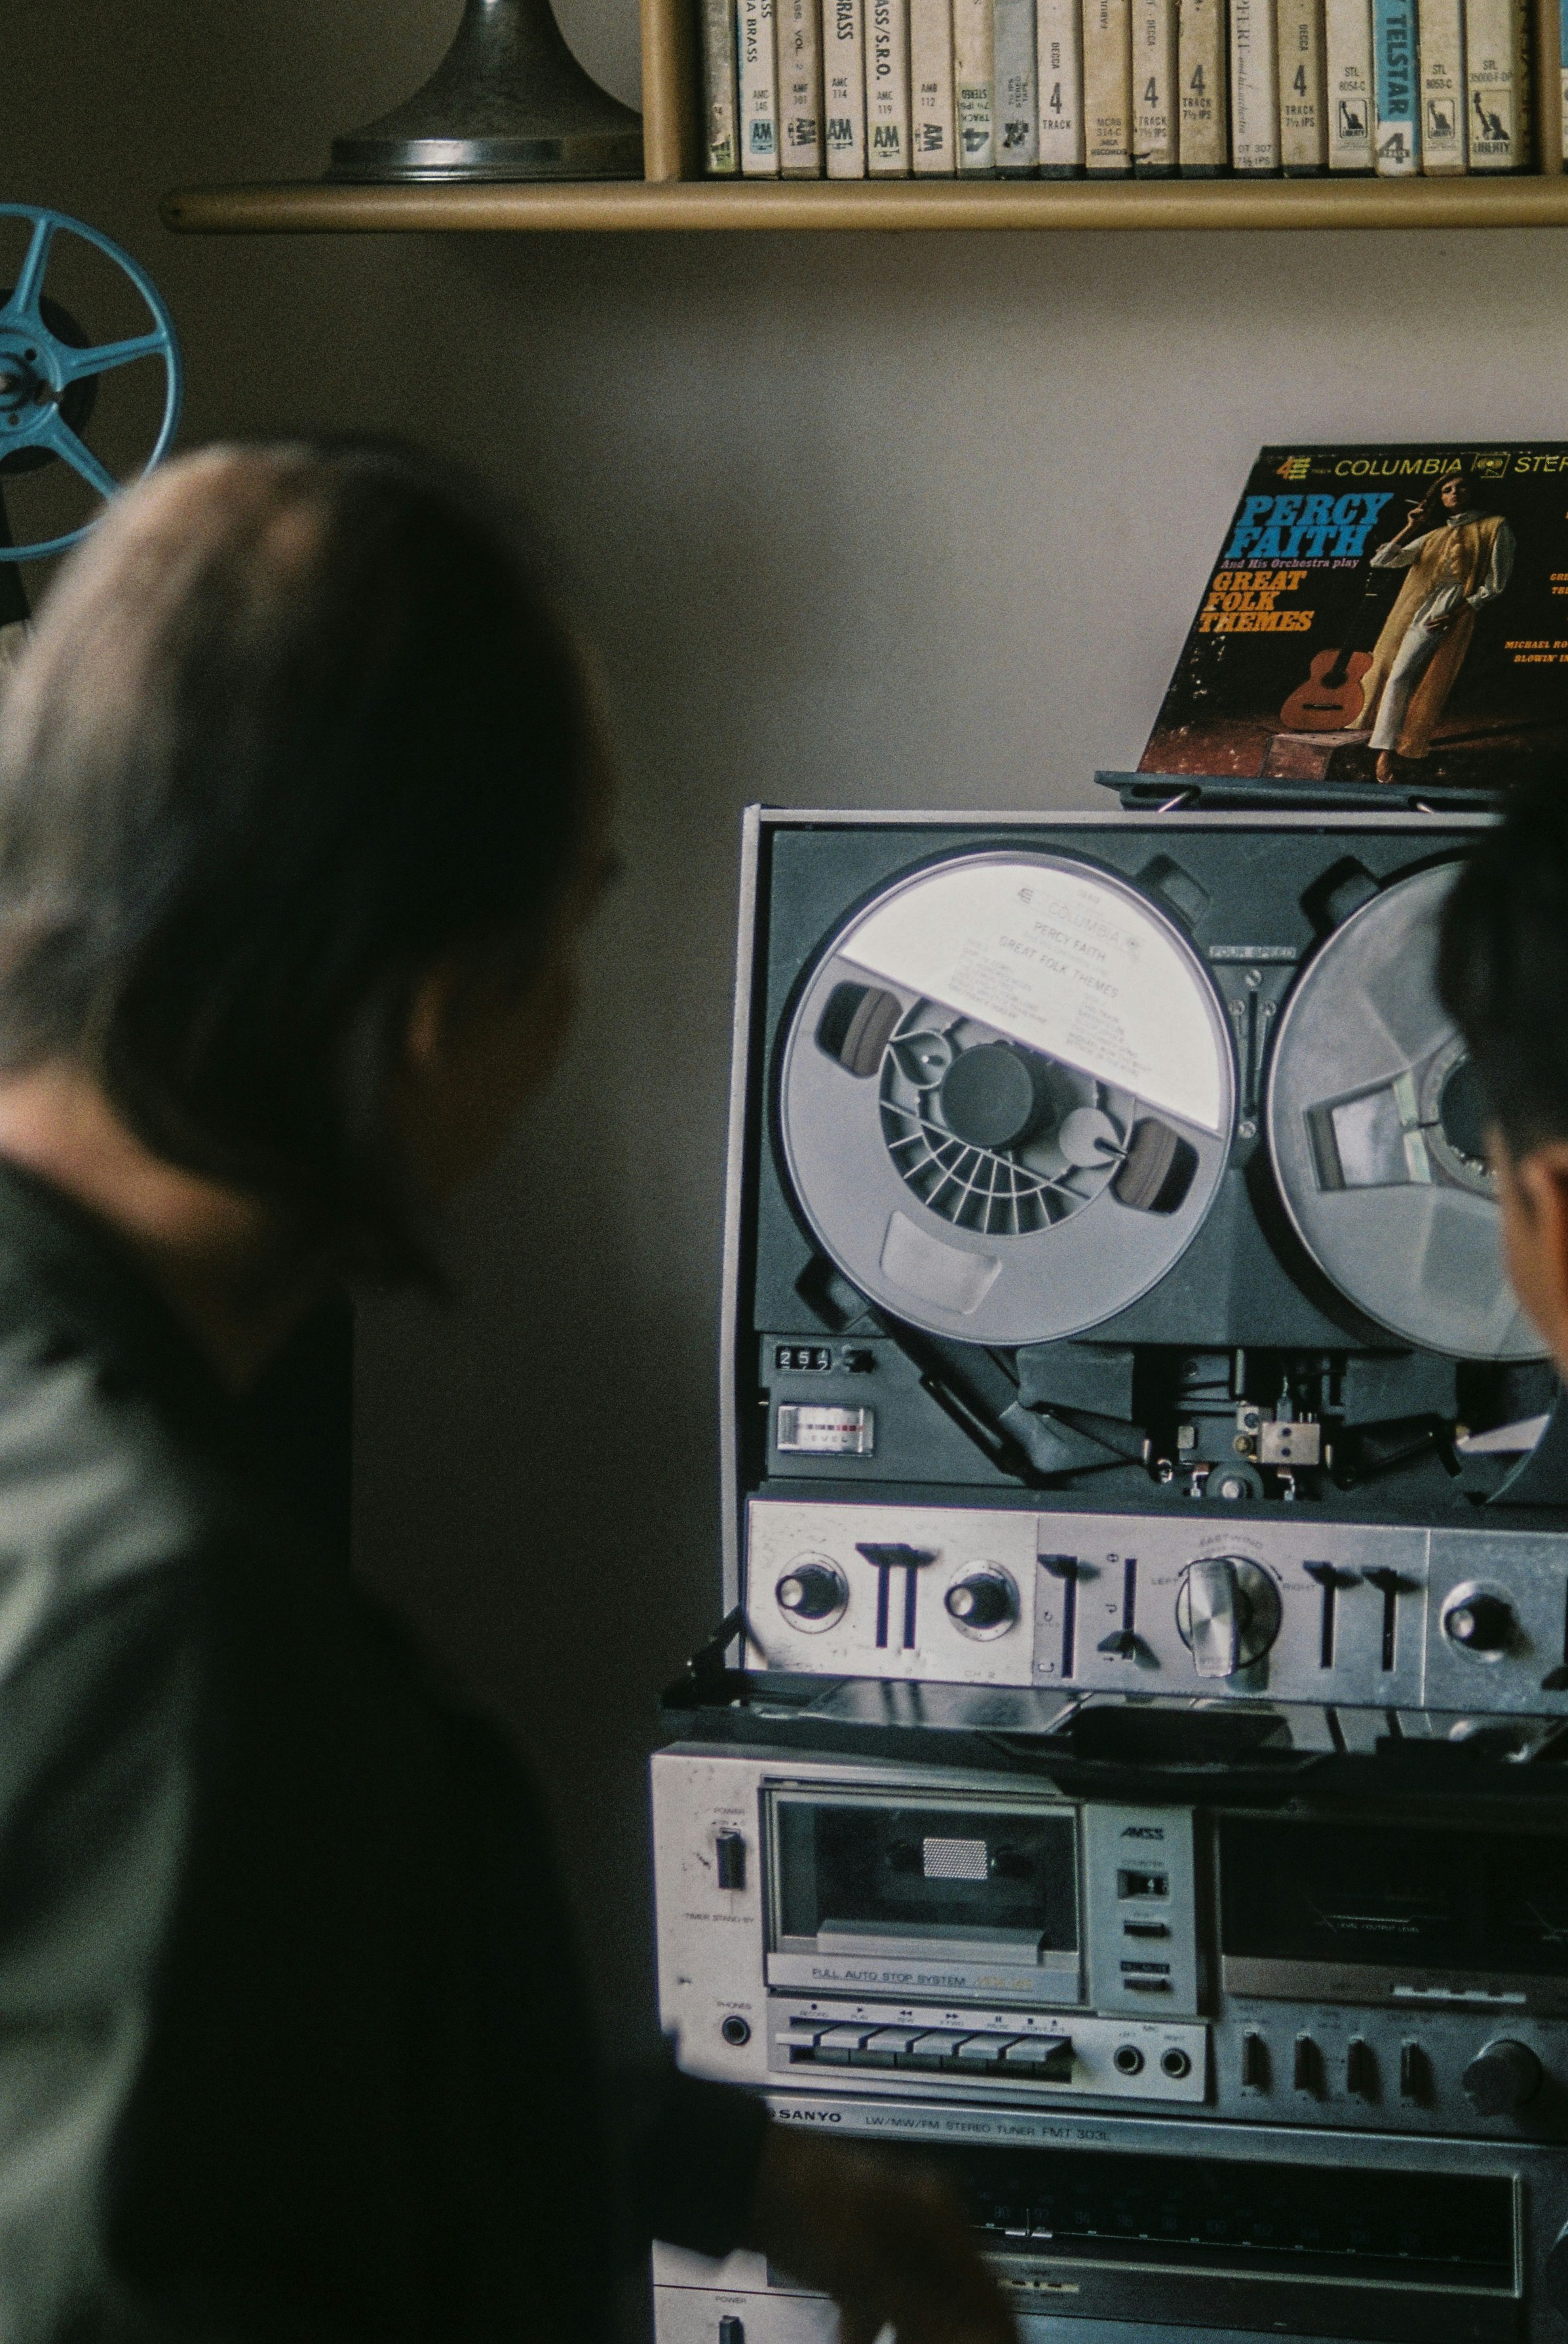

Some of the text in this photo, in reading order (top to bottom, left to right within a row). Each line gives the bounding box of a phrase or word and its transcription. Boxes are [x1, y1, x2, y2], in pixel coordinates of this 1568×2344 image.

[837, 0, 853, 40] RASS
[747, 19, 757, 63] BRASS
[1147, 20, 1156, 46] DECCA
[1299, 24, 1309, 51] DECCA
[1051, 42, 1060, 69] DECCA
[1386, 14, 1408, 115] TELSTAR
[1191, 65, 1206, 96] 4
[1293, 65, 1307, 97] 4
[1345, 66, 1359, 77] STL
[1432, 64, 1447, 75] STL
[962, 89, 987, 99] STEREO
[1144, 77, 1158, 107] 4
[1339, 81, 1366, 91] 8054-C
[1050, 82, 1062, 114] 4
[1183, 98, 1212, 107] TRACK
[1139, 116, 1167, 126] TRACK
[1198, 110, 1212, 119] IPS
[1285, 105, 1314, 115] TRACK
[1042, 119, 1071, 130] TRACK
[1301, 117, 1315, 127] IPS
[963, 128, 989, 152] 4
[1335, 458, 1462, 476] COLUMBIA
[1237, 492, 1394, 527] PERCY
[1224, 524, 1373, 559] FAITH
[1220, 558, 1360, 569] And His Orchestra play
[1212, 570, 1308, 592] GREAT
[1203, 590, 1280, 611] FOLK
[1198, 610, 1315, 632] THEMES
[1048, 901, 1120, 942] COLUMBIA
[1034, 921, 1069, 945] PERCY
[1073, 939, 1106, 961] FAITH
[998, 935, 1037, 960] GREAT
[1039, 953, 1069, 974] FOLK
[1072, 969, 1120, 999] THEMES
[812, 1968, 838, 1980] FULL
[845, 1969, 878, 1981] AUTO
[882, 1972, 913, 1983] STOP
[917, 1974, 966, 1986] SYSTEM
[778, 2109, 842, 2123] SANYO
[946, 2121, 991, 2134] STEREO
[997, 2124, 1035, 2136] TUNER
[715, 2296, 746, 2304] POWER
